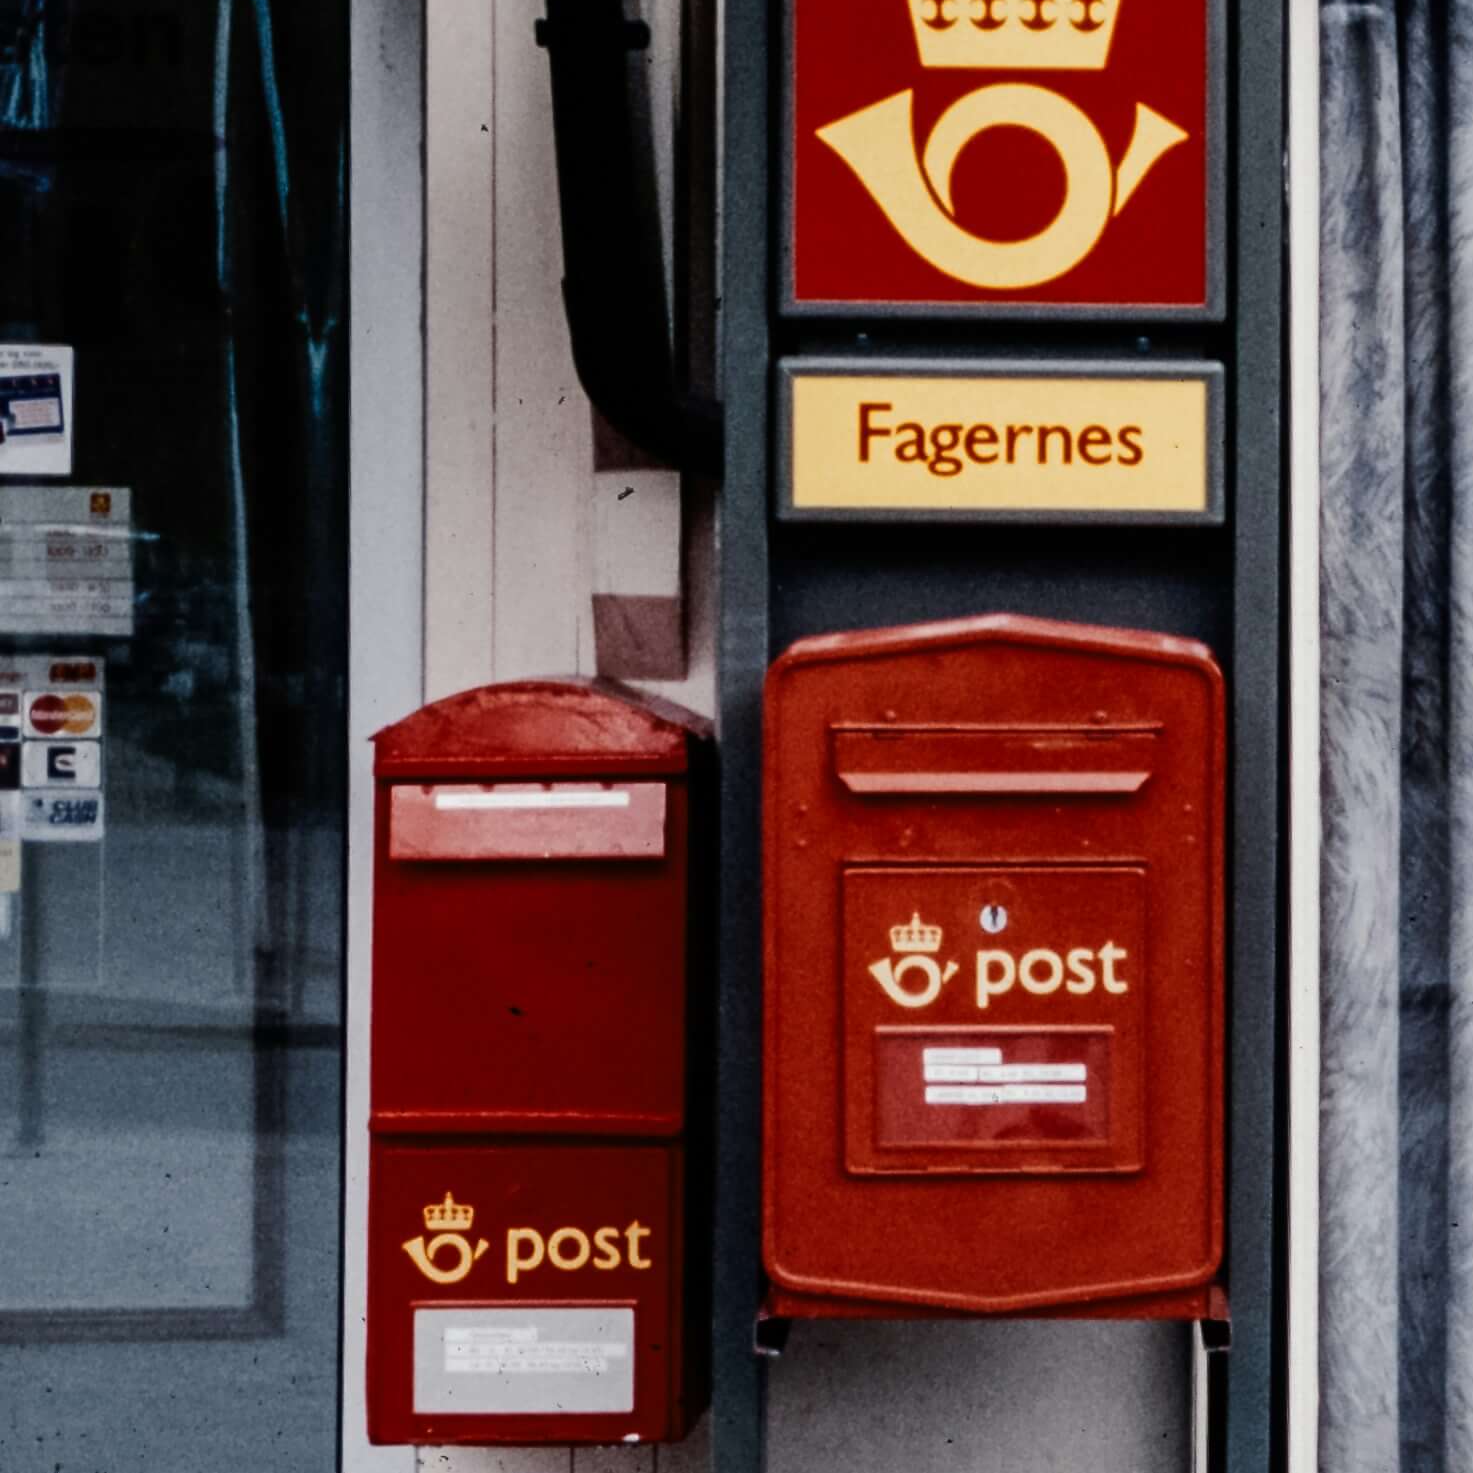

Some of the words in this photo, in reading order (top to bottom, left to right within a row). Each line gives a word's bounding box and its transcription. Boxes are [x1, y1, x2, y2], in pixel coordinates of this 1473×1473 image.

[858, 401, 1144, 478] Fagernes
[975, 940, 1129, 1009] post
[506, 1220, 652, 1285] post
